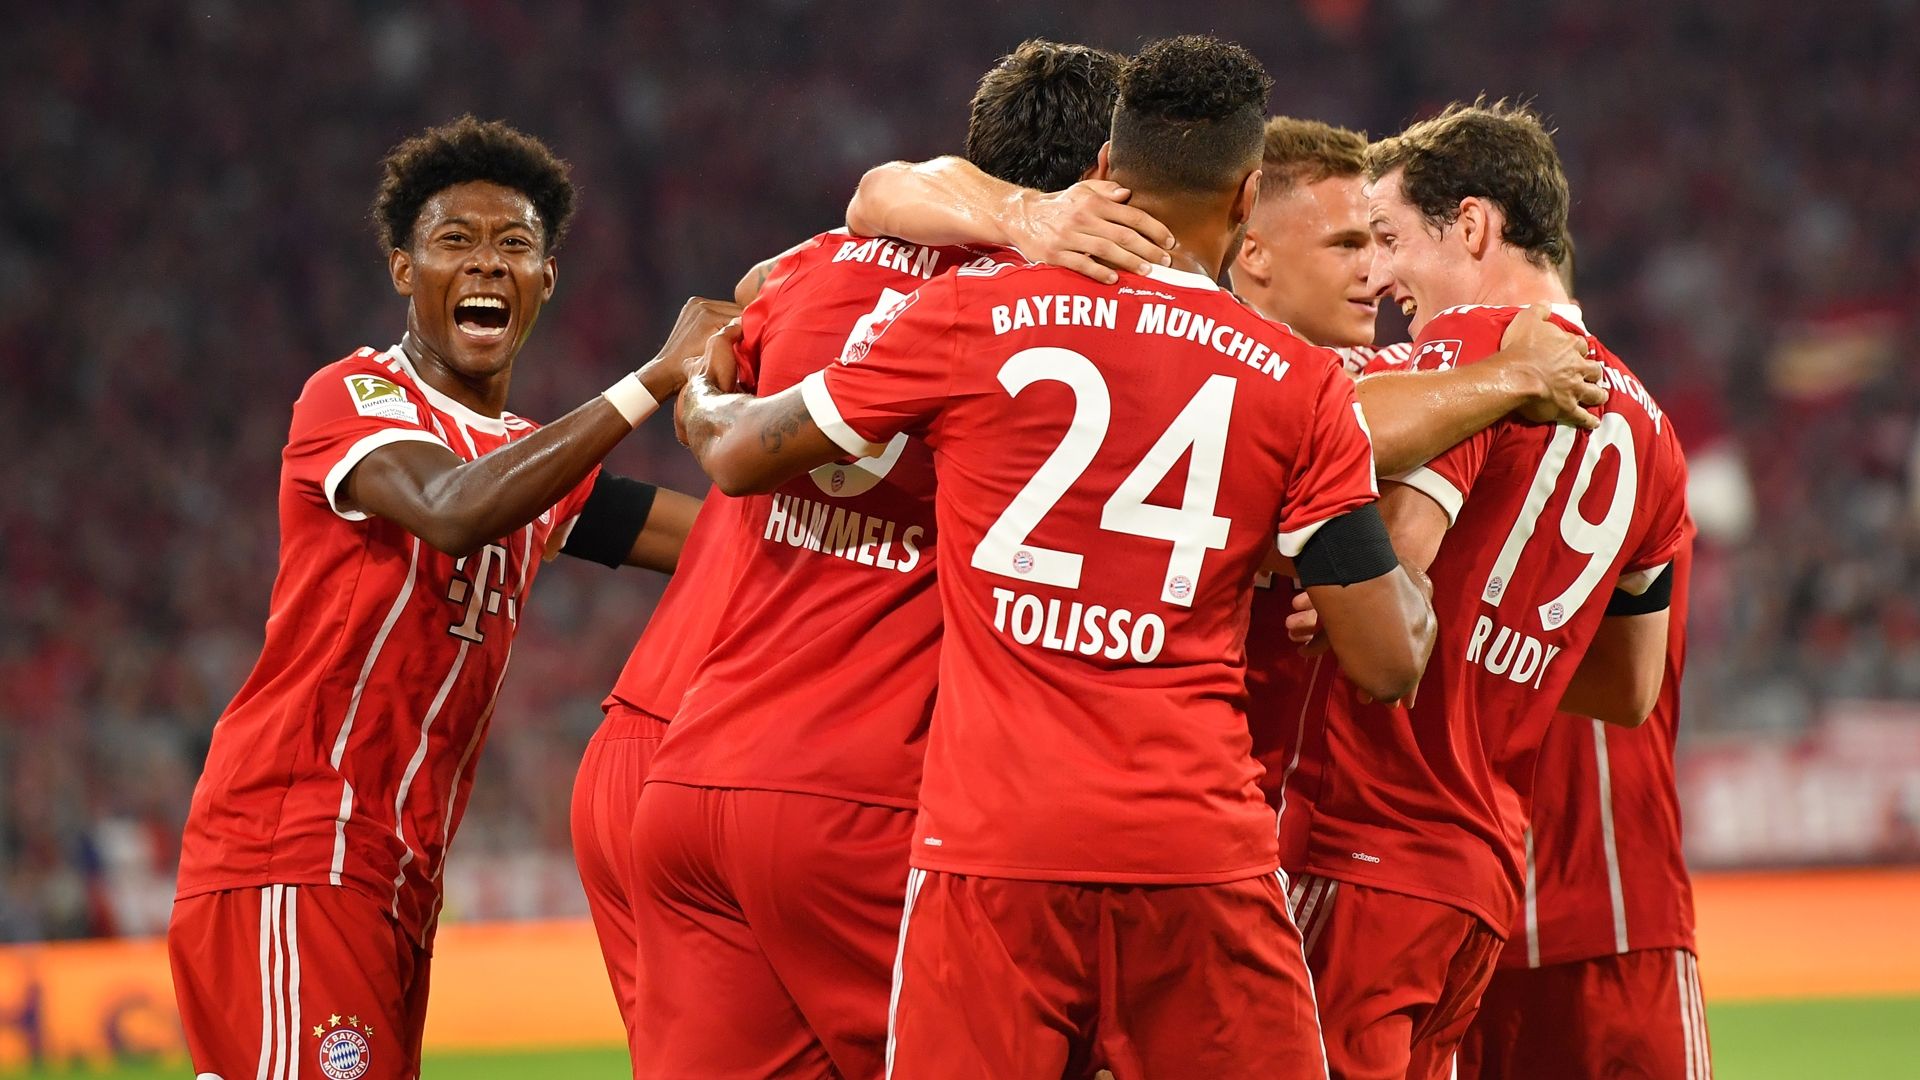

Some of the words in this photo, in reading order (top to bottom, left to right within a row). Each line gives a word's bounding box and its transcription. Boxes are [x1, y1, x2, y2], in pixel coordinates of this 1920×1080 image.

[832, 238, 940, 280] BAYERN
[992, 295, 1118, 335] BAYERN
[1135, 303, 1290, 381] MÜNCHEN
[970, 346, 1238, 607] 24
[763, 492, 925, 573] HUMMELS
[1481, 412, 1638, 631] 19
[992, 587, 1166, 664] TOLISSO
[1466, 615, 1561, 689] RUDY
[322, 1040, 333, 1054] FC
[332, 1032, 367, 1054] BAYERN
